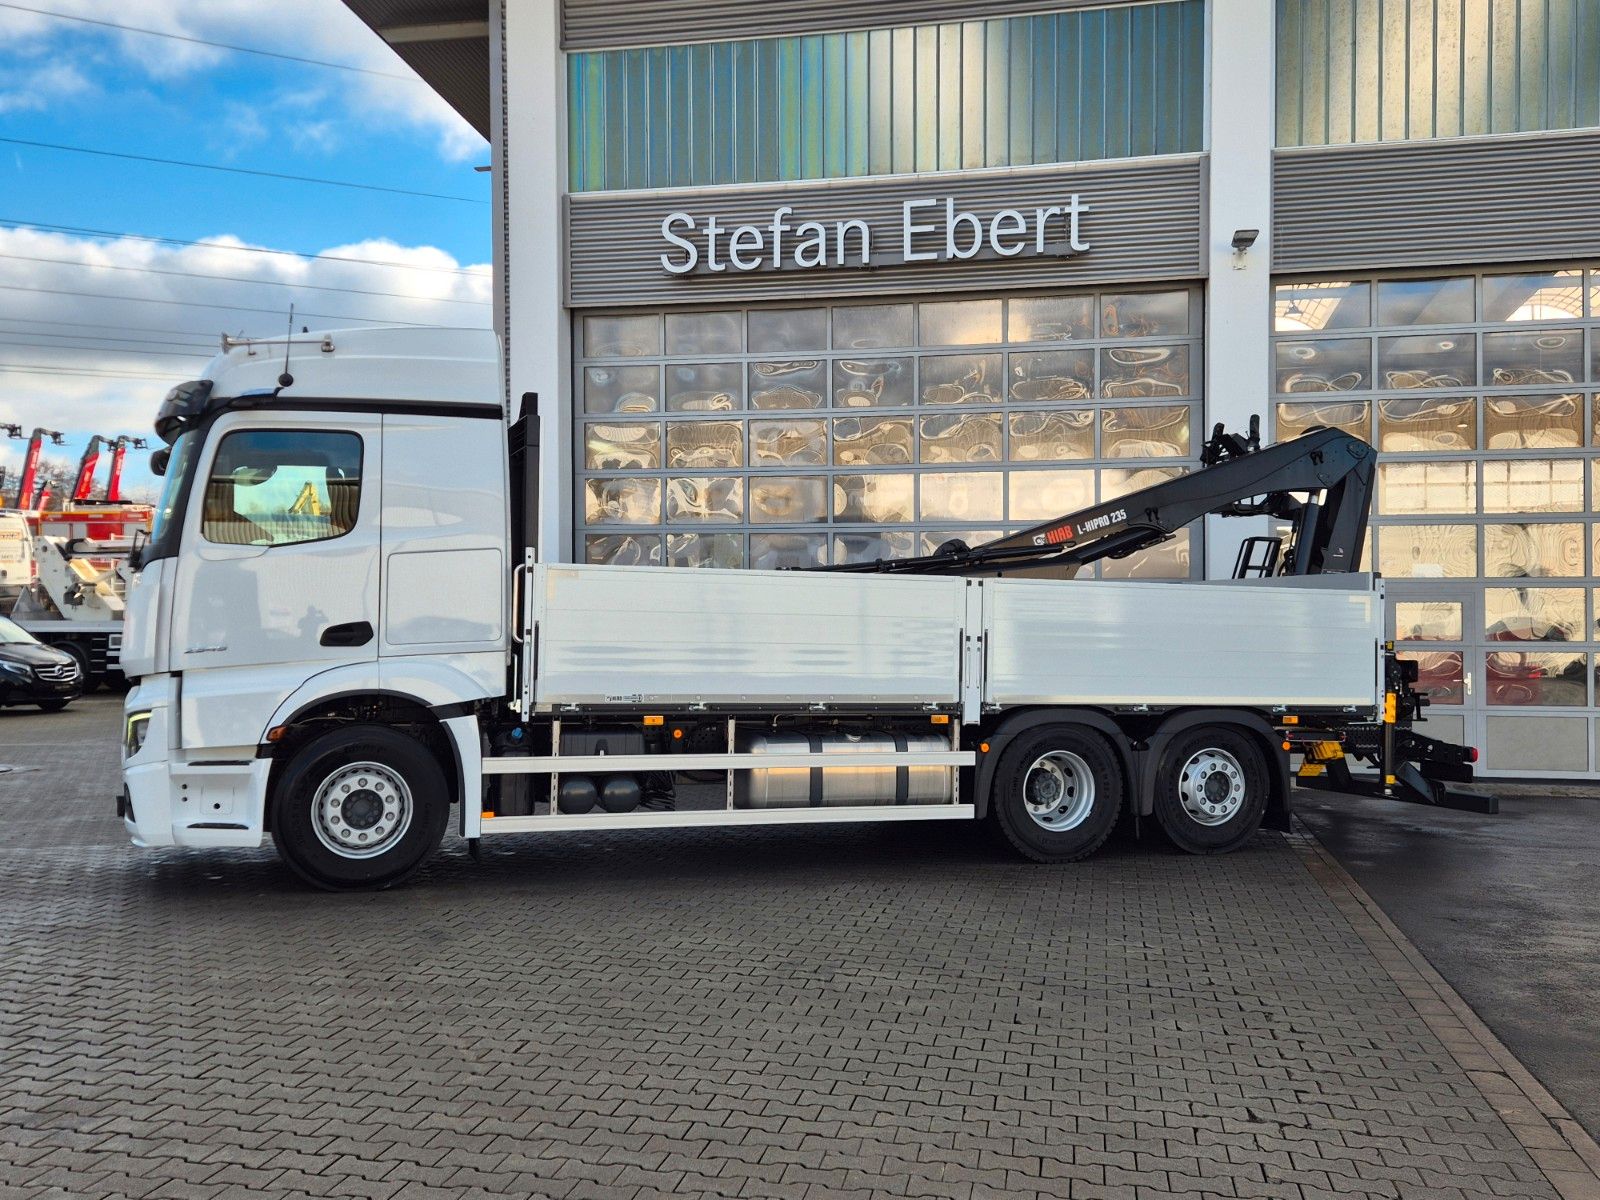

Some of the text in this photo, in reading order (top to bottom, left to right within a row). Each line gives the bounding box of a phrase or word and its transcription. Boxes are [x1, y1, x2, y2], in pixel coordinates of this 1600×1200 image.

[660, 194, 1090, 274] Stefan Ebert
[1046, 509, 1127, 544] HIAB L-HIPRO 235
